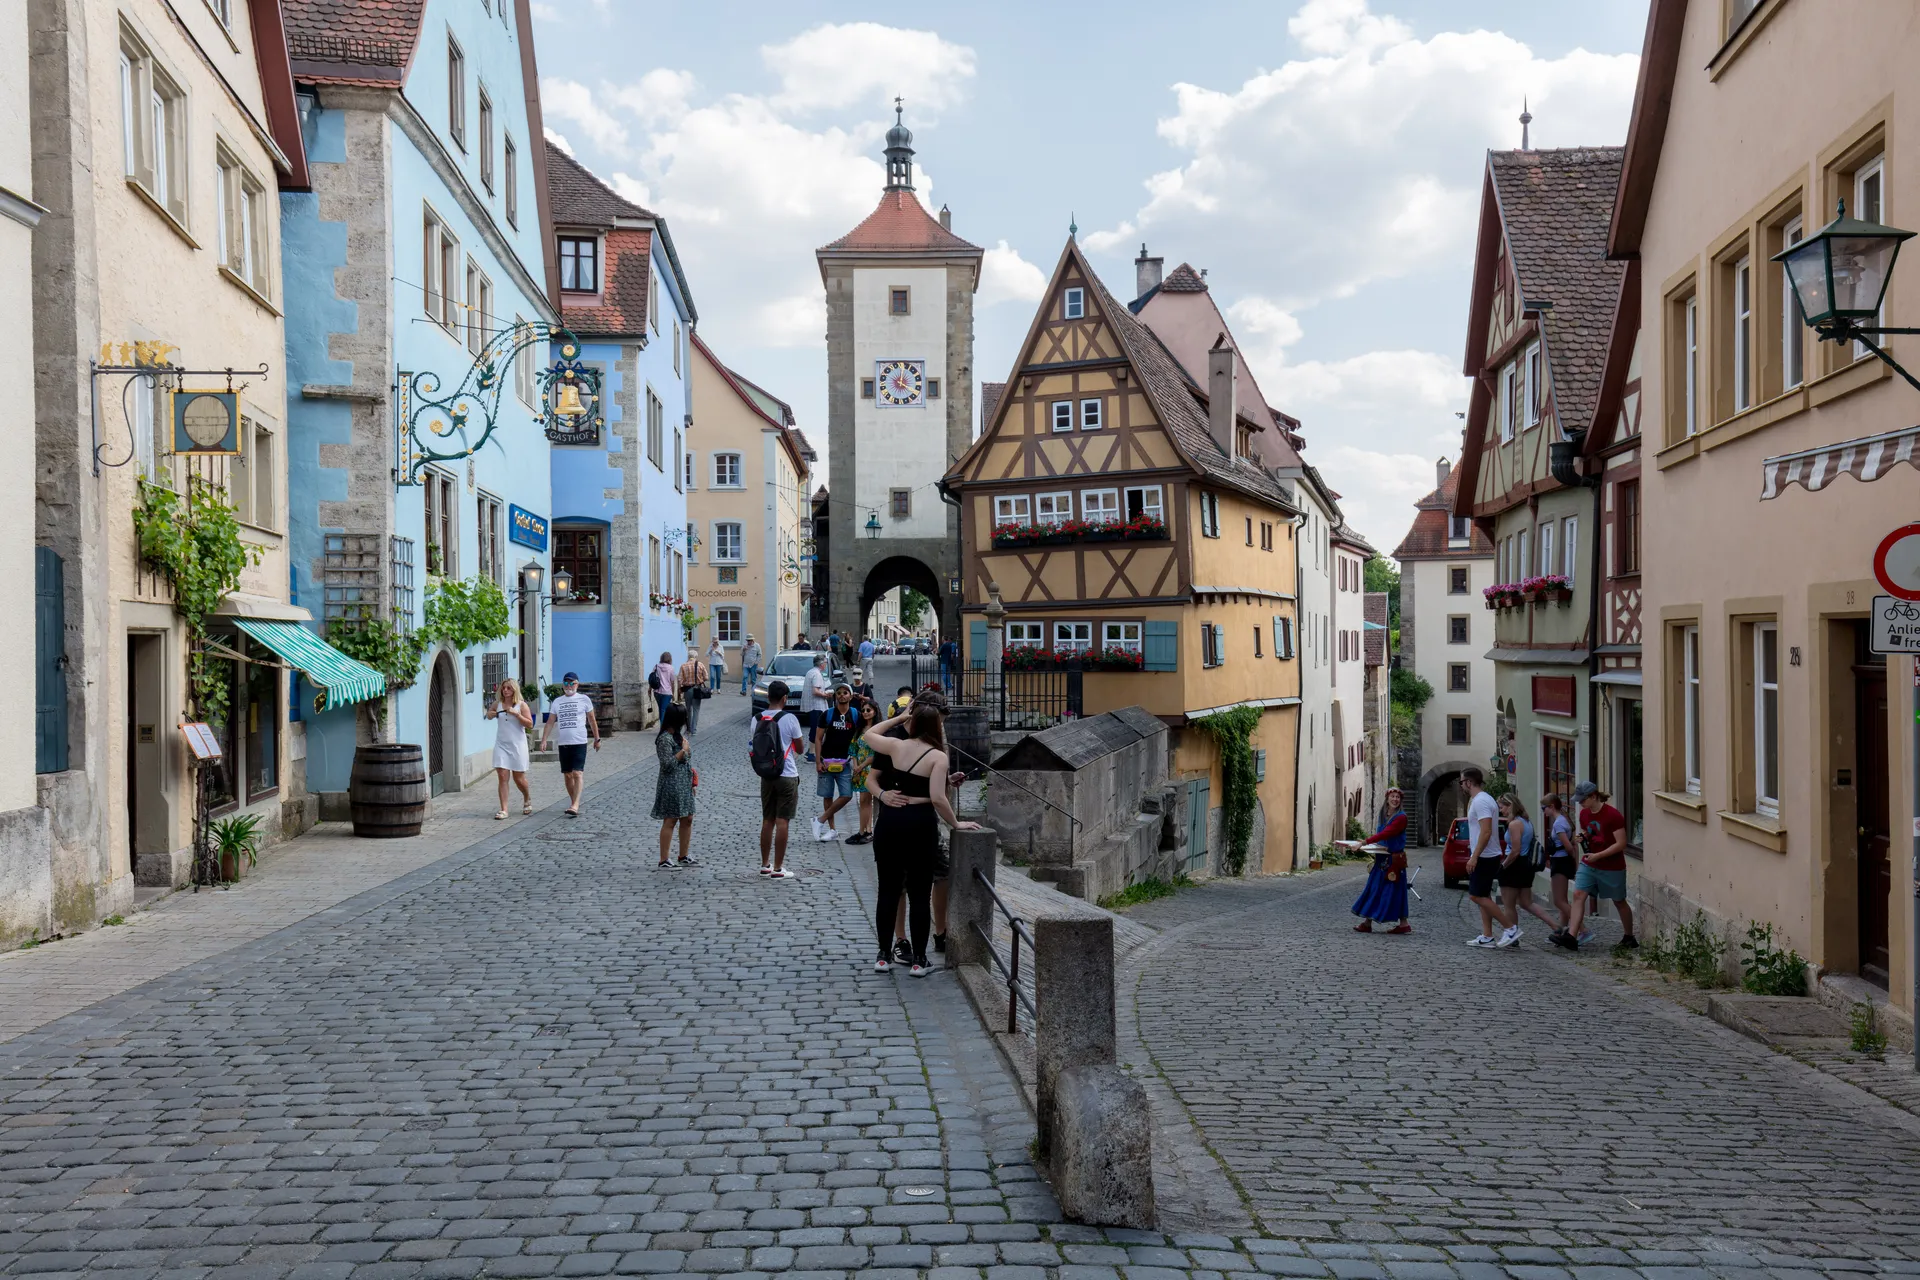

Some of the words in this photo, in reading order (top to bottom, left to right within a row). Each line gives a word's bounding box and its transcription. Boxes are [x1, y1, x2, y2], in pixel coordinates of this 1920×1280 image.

[549, 431, 590, 442] GASTHOF
[687, 589, 748, 598] Chocolaterie
[1846, 590, 1855, 605] 28
[1887, 623, 1920, 635] Anlie
[1789, 646, 1801, 667] 28
